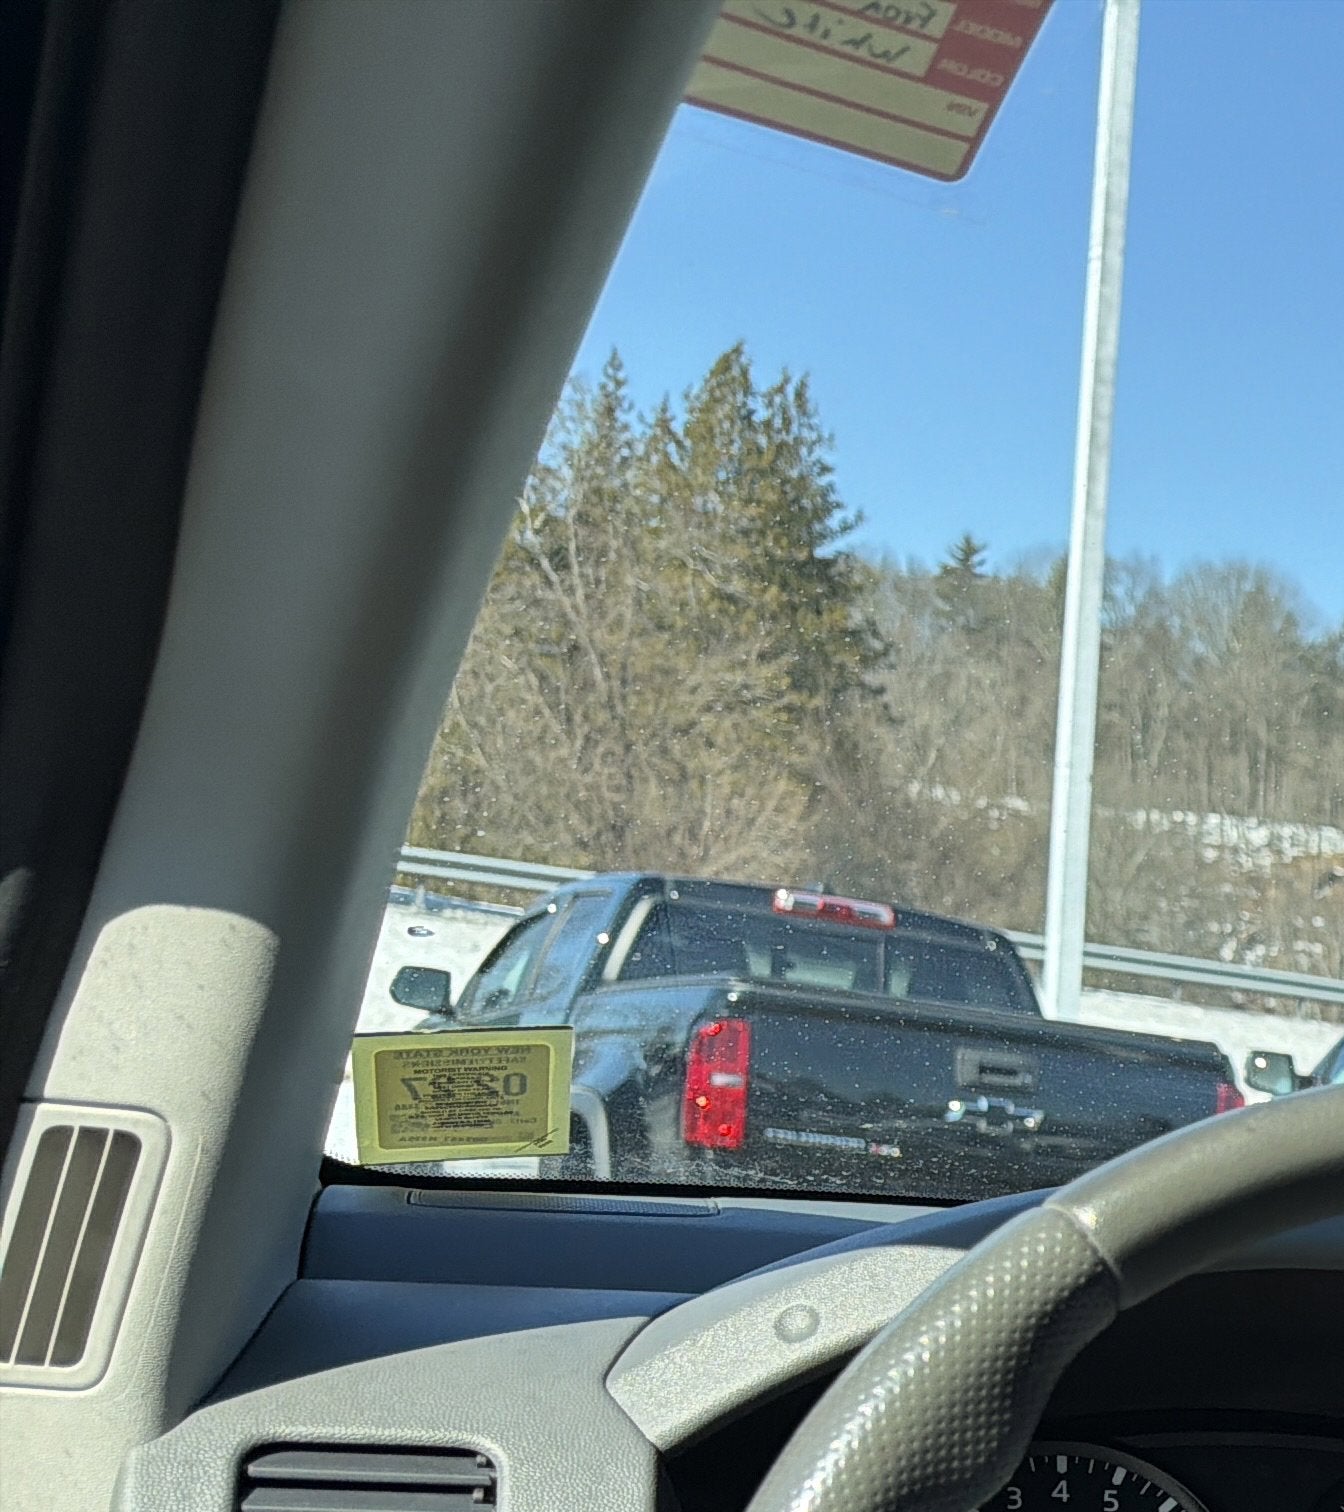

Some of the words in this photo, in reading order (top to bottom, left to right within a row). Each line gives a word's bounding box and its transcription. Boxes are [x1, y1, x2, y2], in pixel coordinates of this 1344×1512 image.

[1006, 1486, 1023, 1509] 3
[1051, 1479, 1070, 1502] 4
[1103, 1489, 1120, 1512] 5
